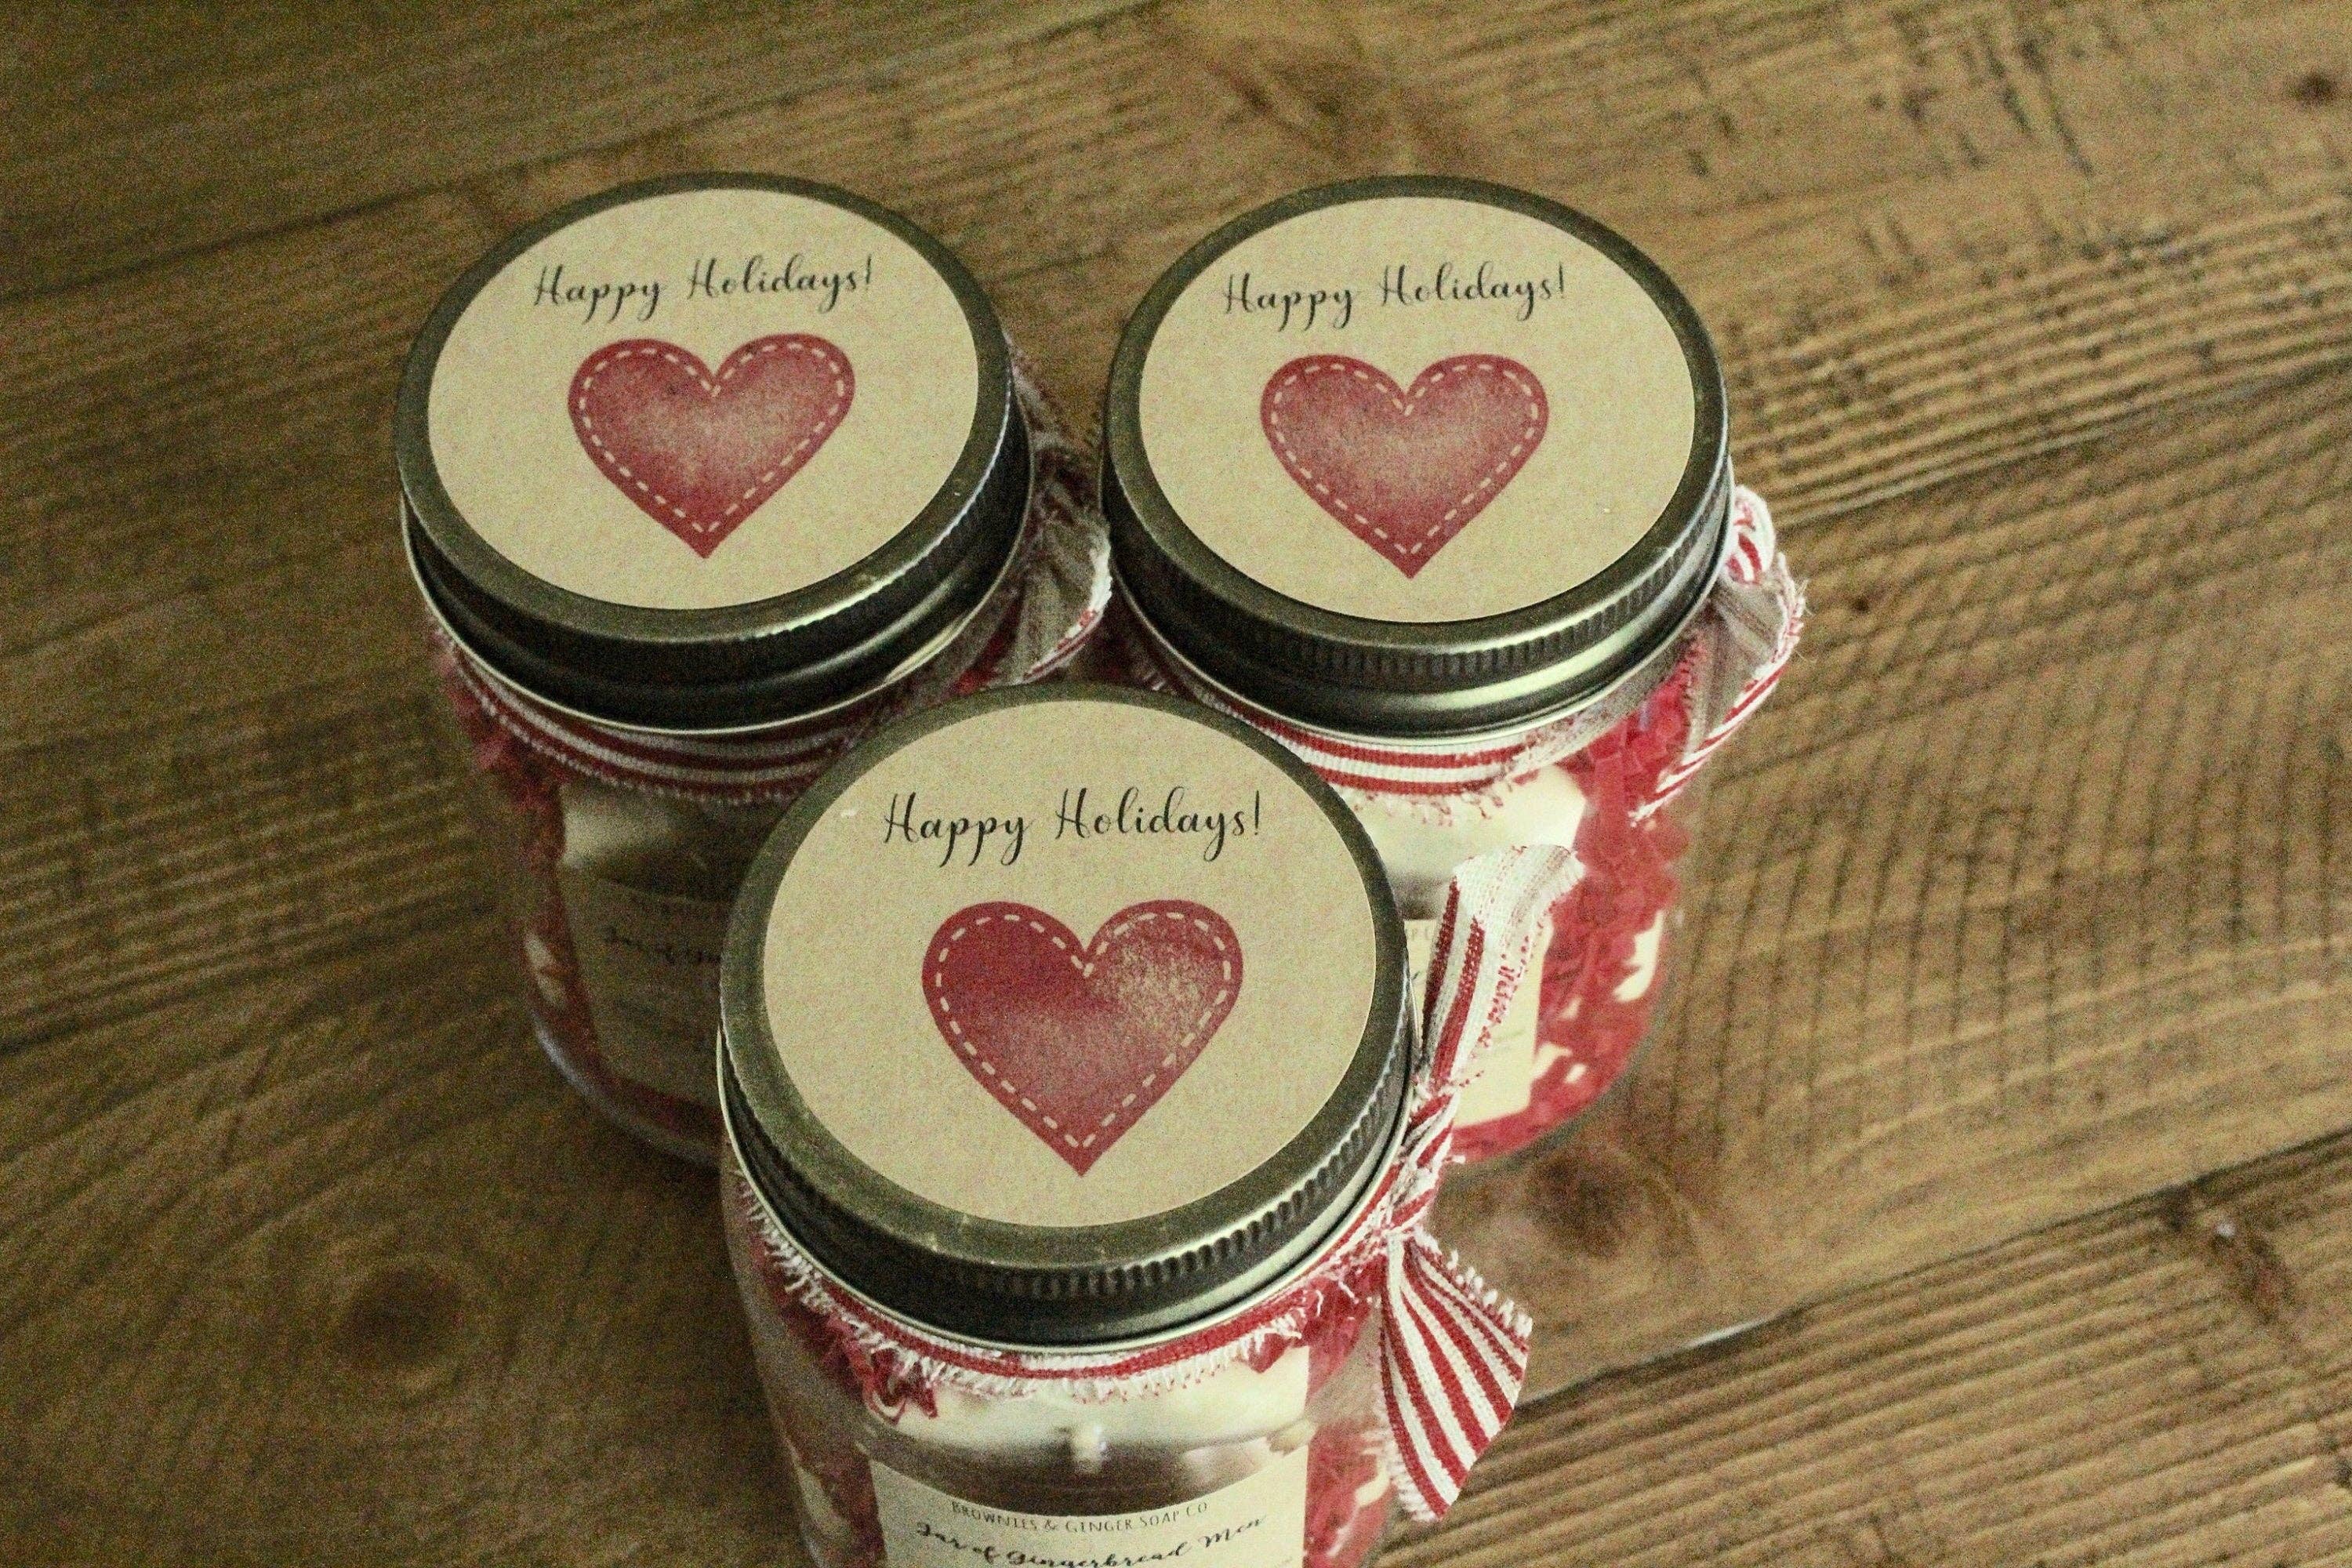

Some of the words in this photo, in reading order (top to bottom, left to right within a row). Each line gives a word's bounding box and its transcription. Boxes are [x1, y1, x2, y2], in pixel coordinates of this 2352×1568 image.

[533, 263, 662, 324] Happy
[686, 253, 872, 314] Holidays!
[1223, 271, 1358, 332] Happy
[1379, 260, 1565, 321] Holidays!
[884, 791, 1033, 867] Happy
[1055, 786, 1260, 862] Holidays!
[913, 1521, 969, 1550] Jar
[1198, 1515, 1268, 1548] Men
[951, 1501, 1037, 1530] BROWNIES
[1044, 1519, 1058, 1531] &
[1065, 1518, 1134, 1533] GINGER
[1139, 1510, 1180, 1528] SOAP
